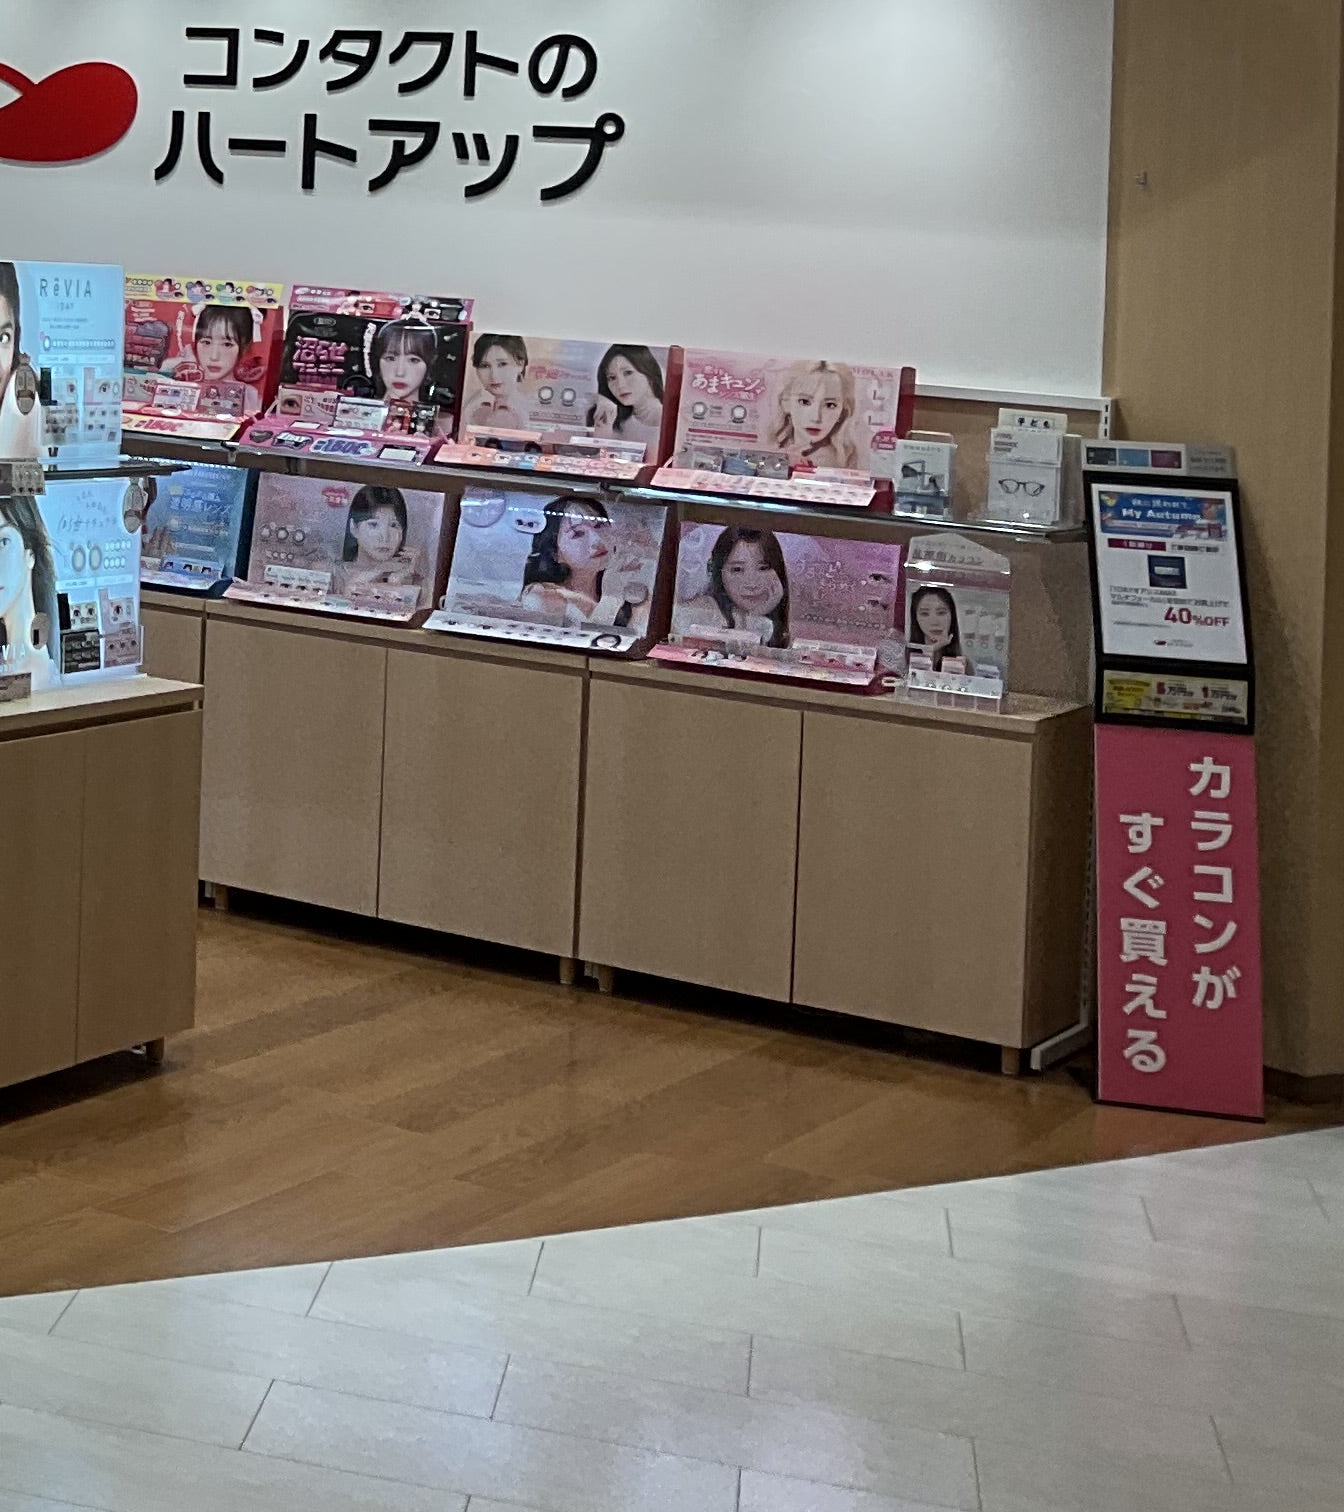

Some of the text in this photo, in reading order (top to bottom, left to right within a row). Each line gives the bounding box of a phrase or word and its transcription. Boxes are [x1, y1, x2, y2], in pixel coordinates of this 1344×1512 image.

[182, 26, 599, 101] コンタクトの
[153, 109, 627, 202] ハートアップ
[1163, 606, 1231, 627] 40%OFF
[1188, 755, 1243, 1011] カラコンが
[1118, 811, 1169, 1074] すぐ買える
